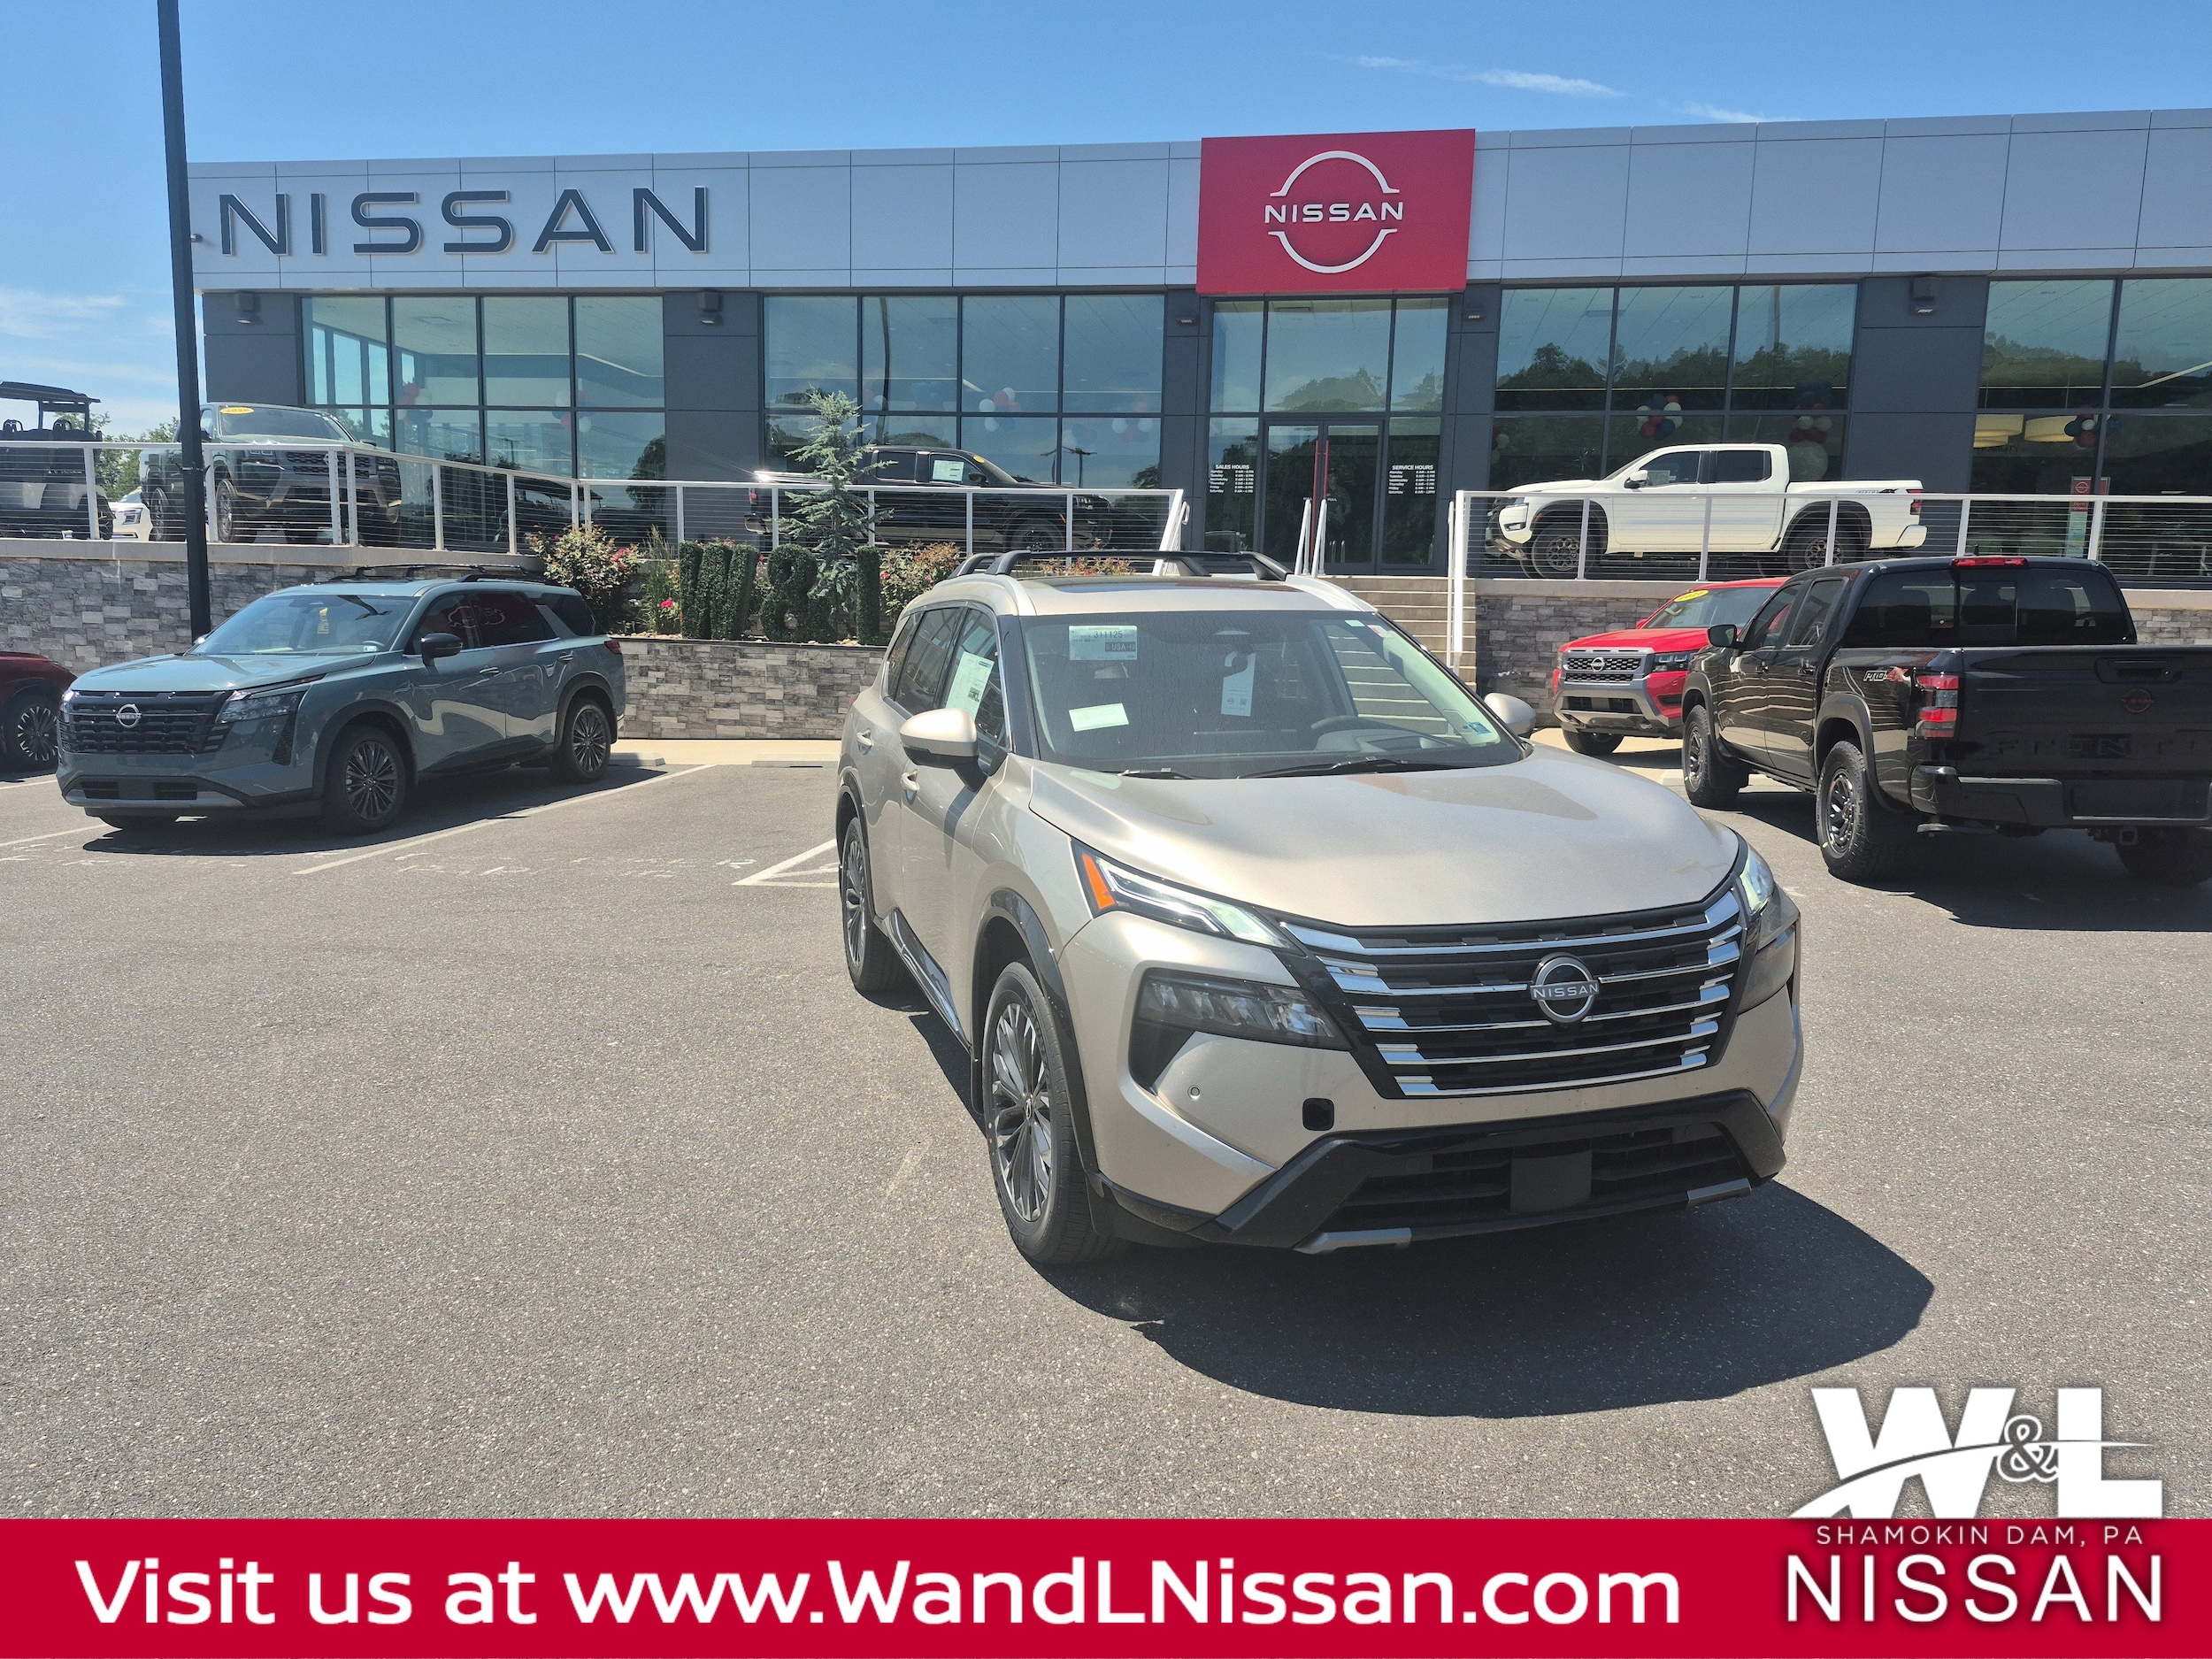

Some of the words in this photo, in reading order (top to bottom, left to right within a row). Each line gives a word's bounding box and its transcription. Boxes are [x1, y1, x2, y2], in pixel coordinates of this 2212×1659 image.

[219, 186, 710, 256] NISSAN
[1264, 201, 1403, 224] NISSAN
[1094, 630, 1123, 639] 311125
[1533, 983, 1598, 999] NISSAN
